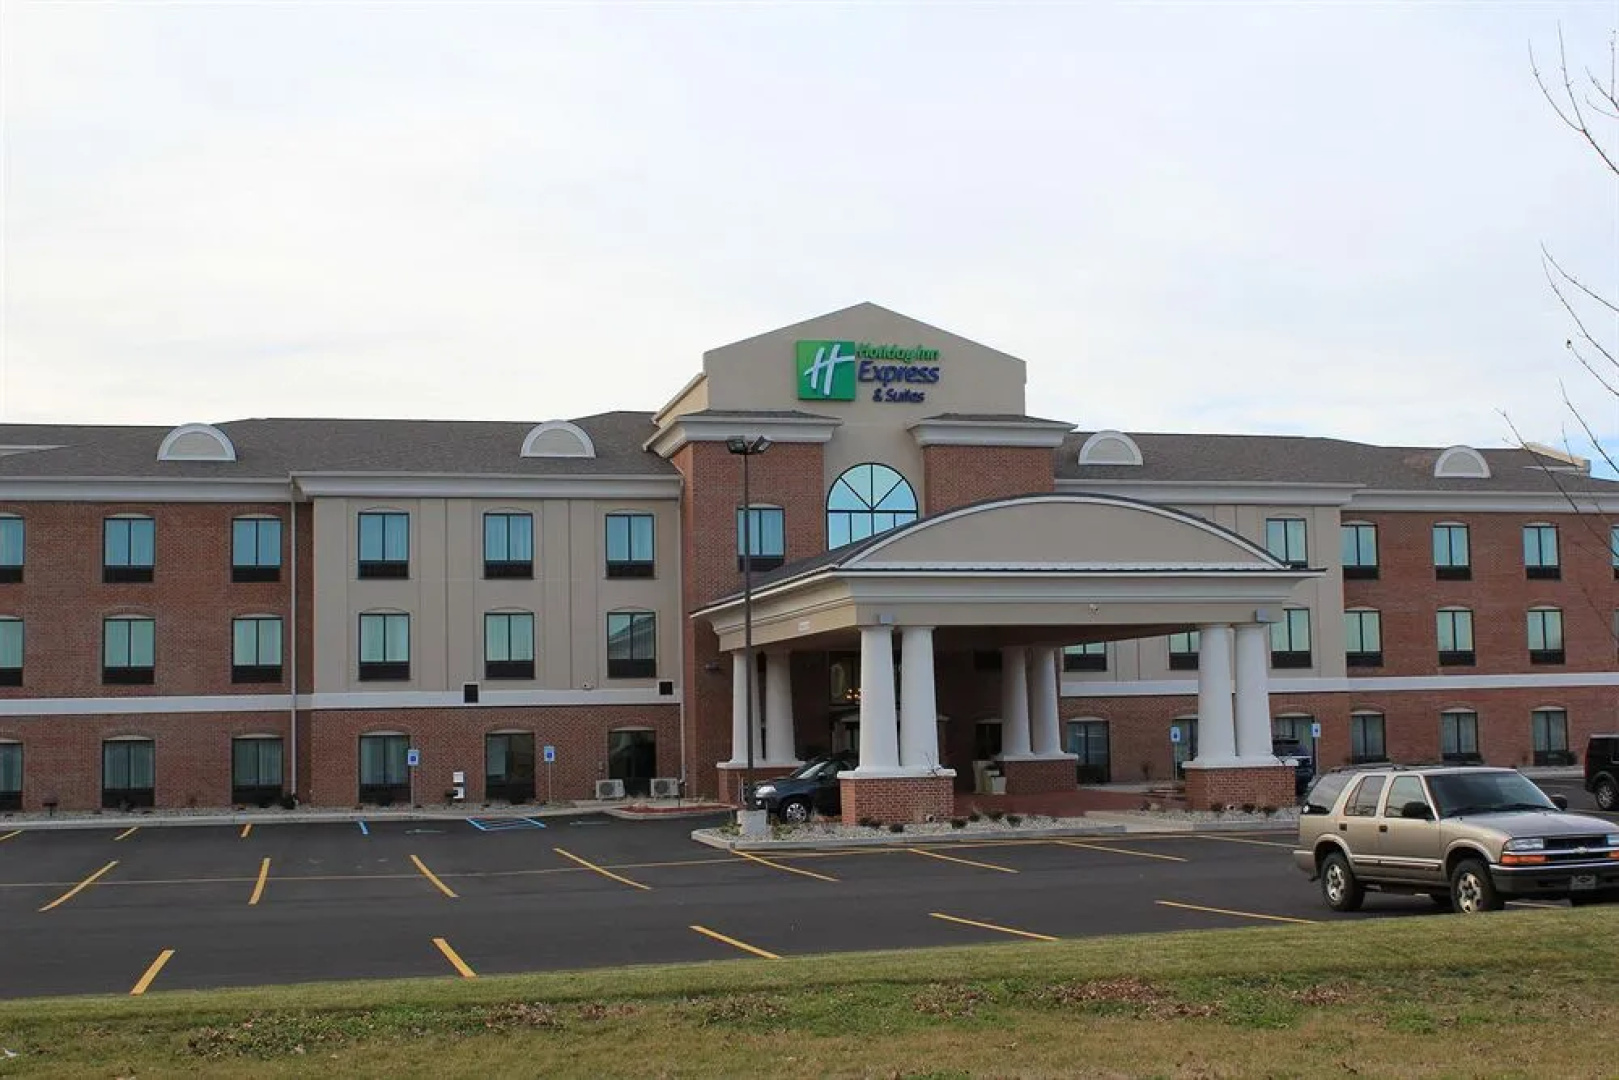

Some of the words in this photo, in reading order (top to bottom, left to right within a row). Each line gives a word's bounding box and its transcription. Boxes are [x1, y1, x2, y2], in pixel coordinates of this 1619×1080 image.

[856, 343, 916, 364] Holiday
[917, 343, 940, 361] Inn
[858, 360, 940, 387] Express
[872, 388, 883, 402] &
[885, 388, 926, 403] Suites
